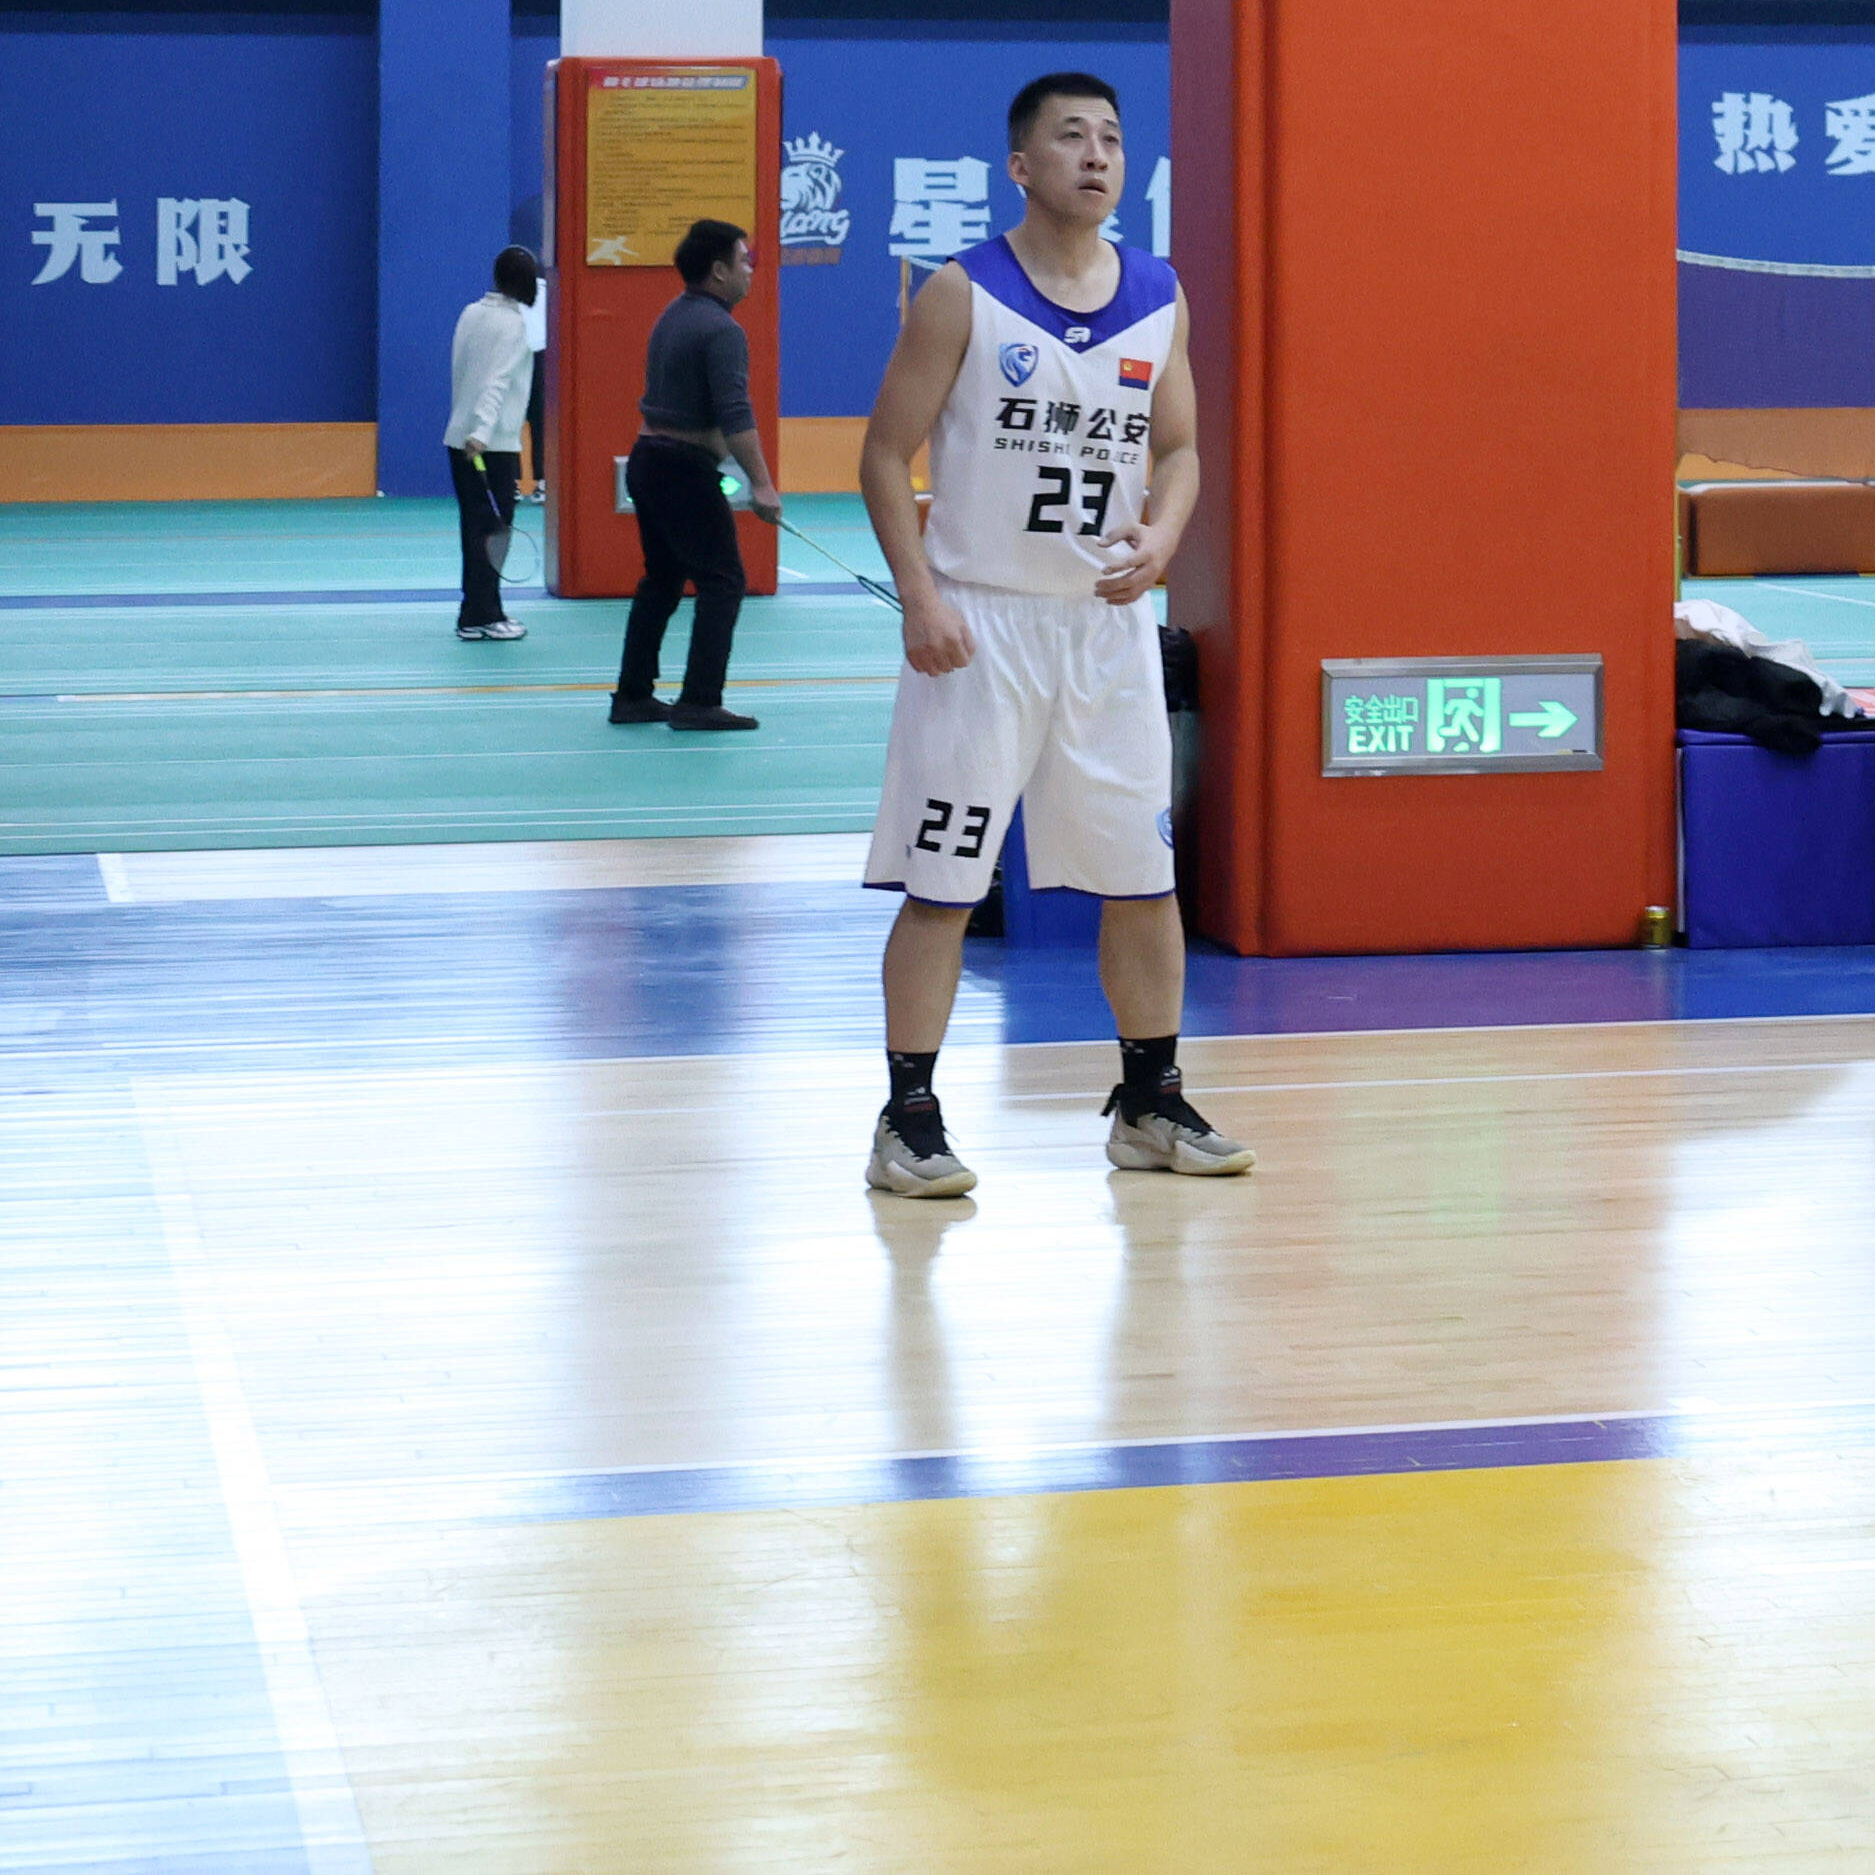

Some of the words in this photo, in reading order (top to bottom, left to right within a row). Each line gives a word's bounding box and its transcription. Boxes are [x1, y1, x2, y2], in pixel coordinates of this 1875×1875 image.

[30, 197, 253, 286] 无限
[995, 397, 1150, 445] 石狮公安
[993, 437, 1070, 455] SHISHI
[1024, 466, 1116, 537] 23
[1344, 694, 1419, 724] 安全出口
[1349, 725, 1415, 754] EXIT
[913, 799, 991, 859] 23
